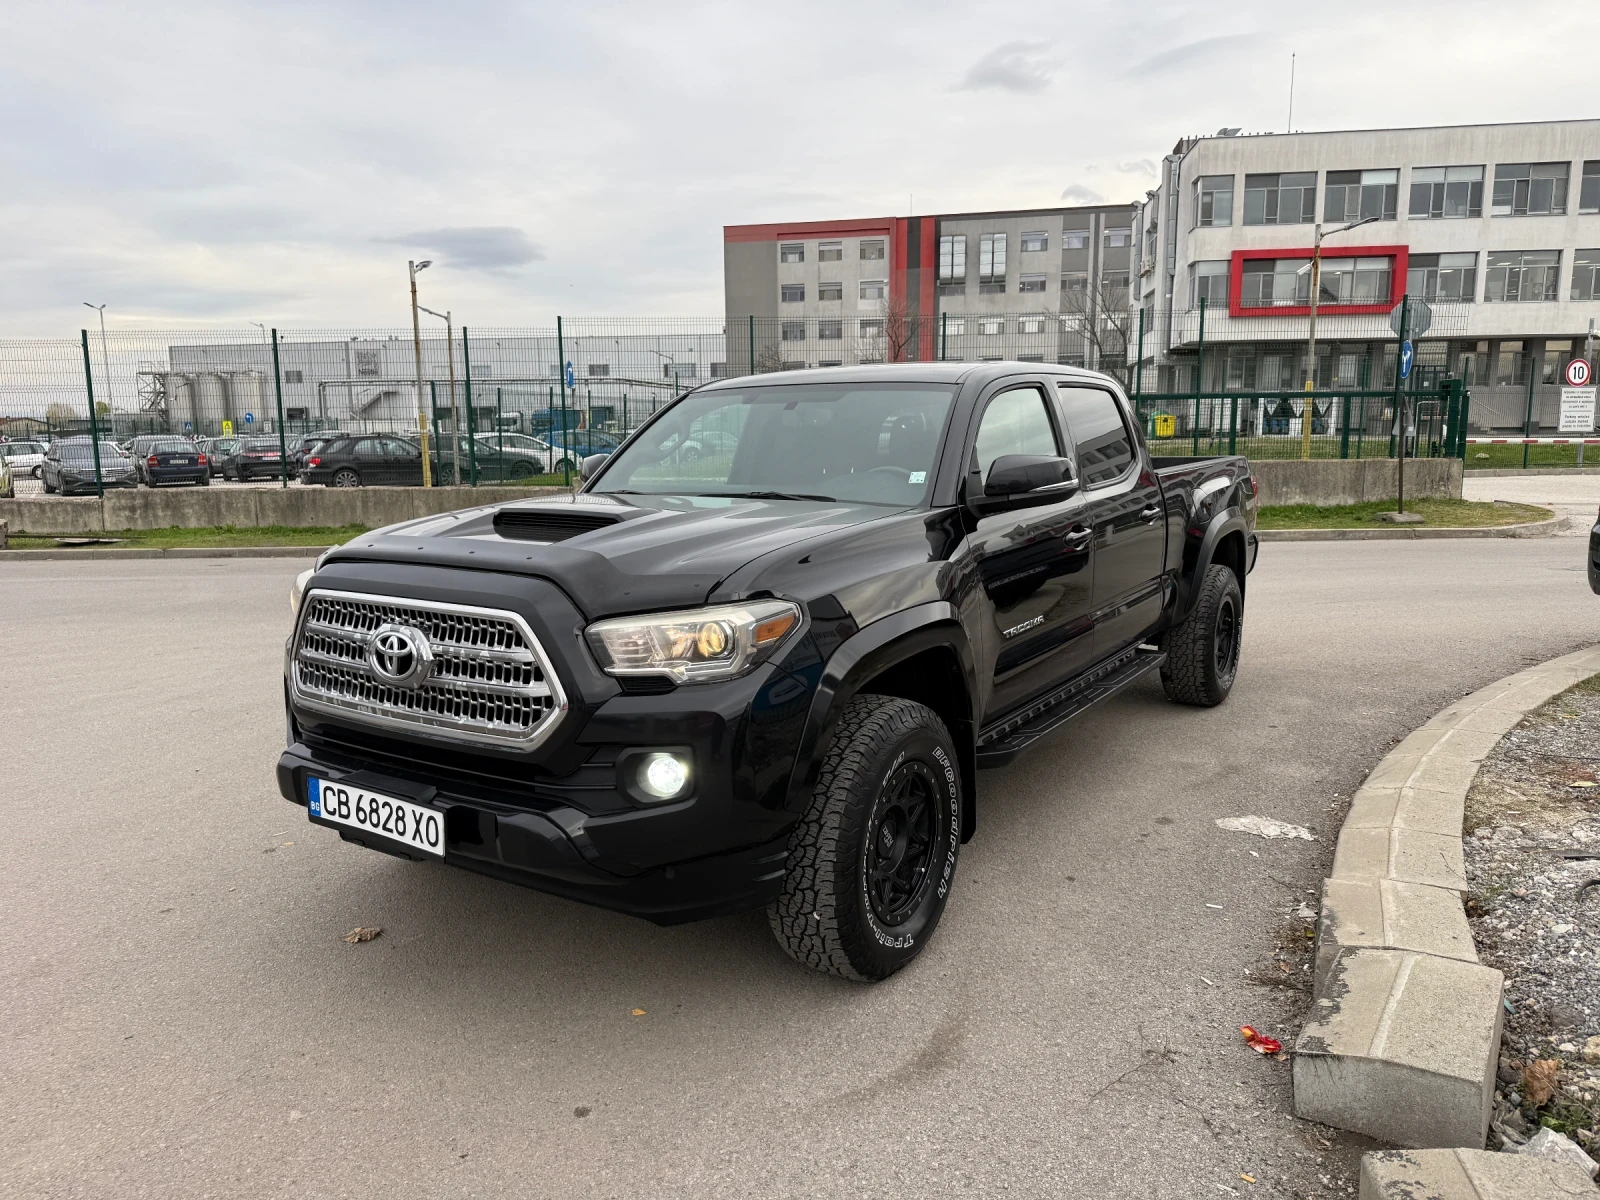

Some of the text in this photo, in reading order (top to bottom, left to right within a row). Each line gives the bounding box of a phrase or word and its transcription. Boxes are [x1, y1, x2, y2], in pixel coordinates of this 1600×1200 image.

[1573, 366, 1585, 380] 10
[1003, 615, 1045, 639] TACOMA
[311, 800, 320, 811] BG
[322, 785, 440, 848] CB 6828 XO
